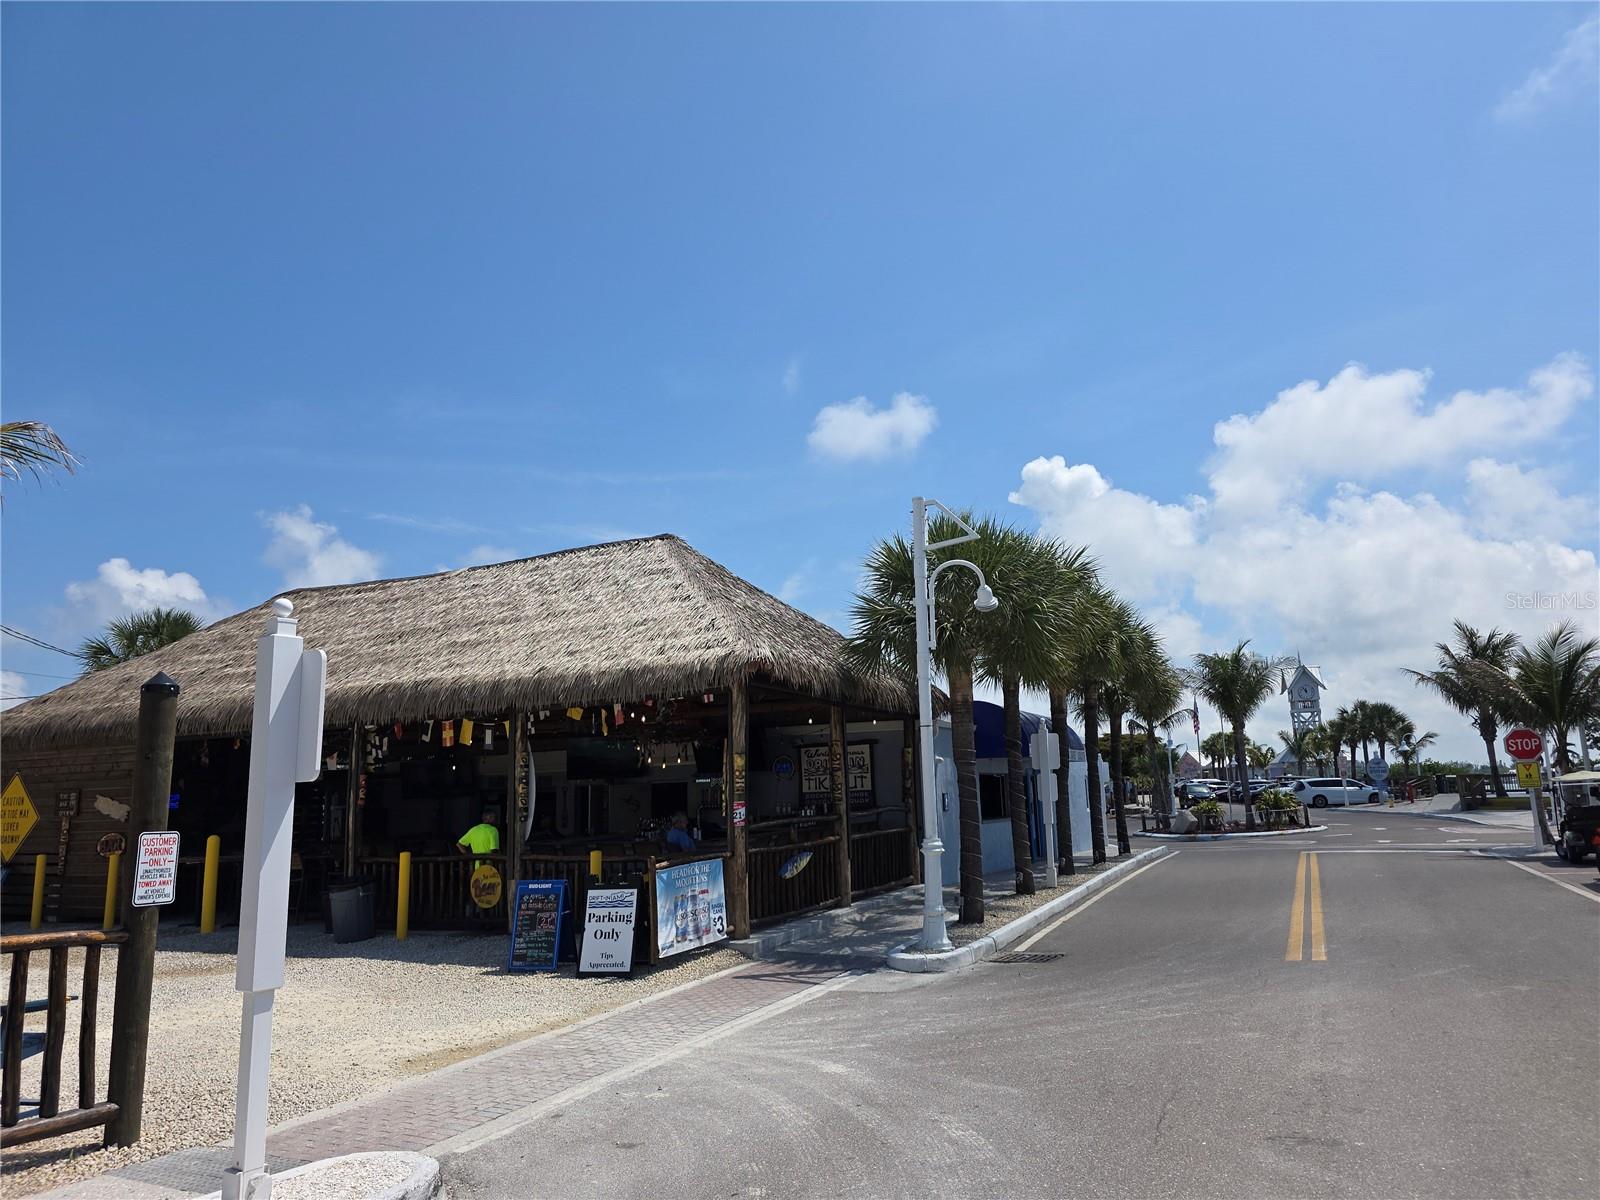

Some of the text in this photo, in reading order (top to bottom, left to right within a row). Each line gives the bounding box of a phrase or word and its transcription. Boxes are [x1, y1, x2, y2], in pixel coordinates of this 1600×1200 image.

[1508, 738, 1540, 751] STOP
[804, 776, 829, 790] TIK
[142, 837, 177, 847] CUSTOMER
[144, 847, 173, 857] PARKING
[148, 857, 167, 867] ONLY
[671, 863, 712, 879] HEAD FOR THE
[138, 879, 172, 888] TOWED AWAY
[155, 892, 171, 900] EXPENSE
[587, 911, 633, 925] Parking
[712, 915, 725, 934] $3
[593, 928, 622, 942] Only
[600, 952, 614, 960] Tips
[587, 961, 626, 969] Appreciated.
